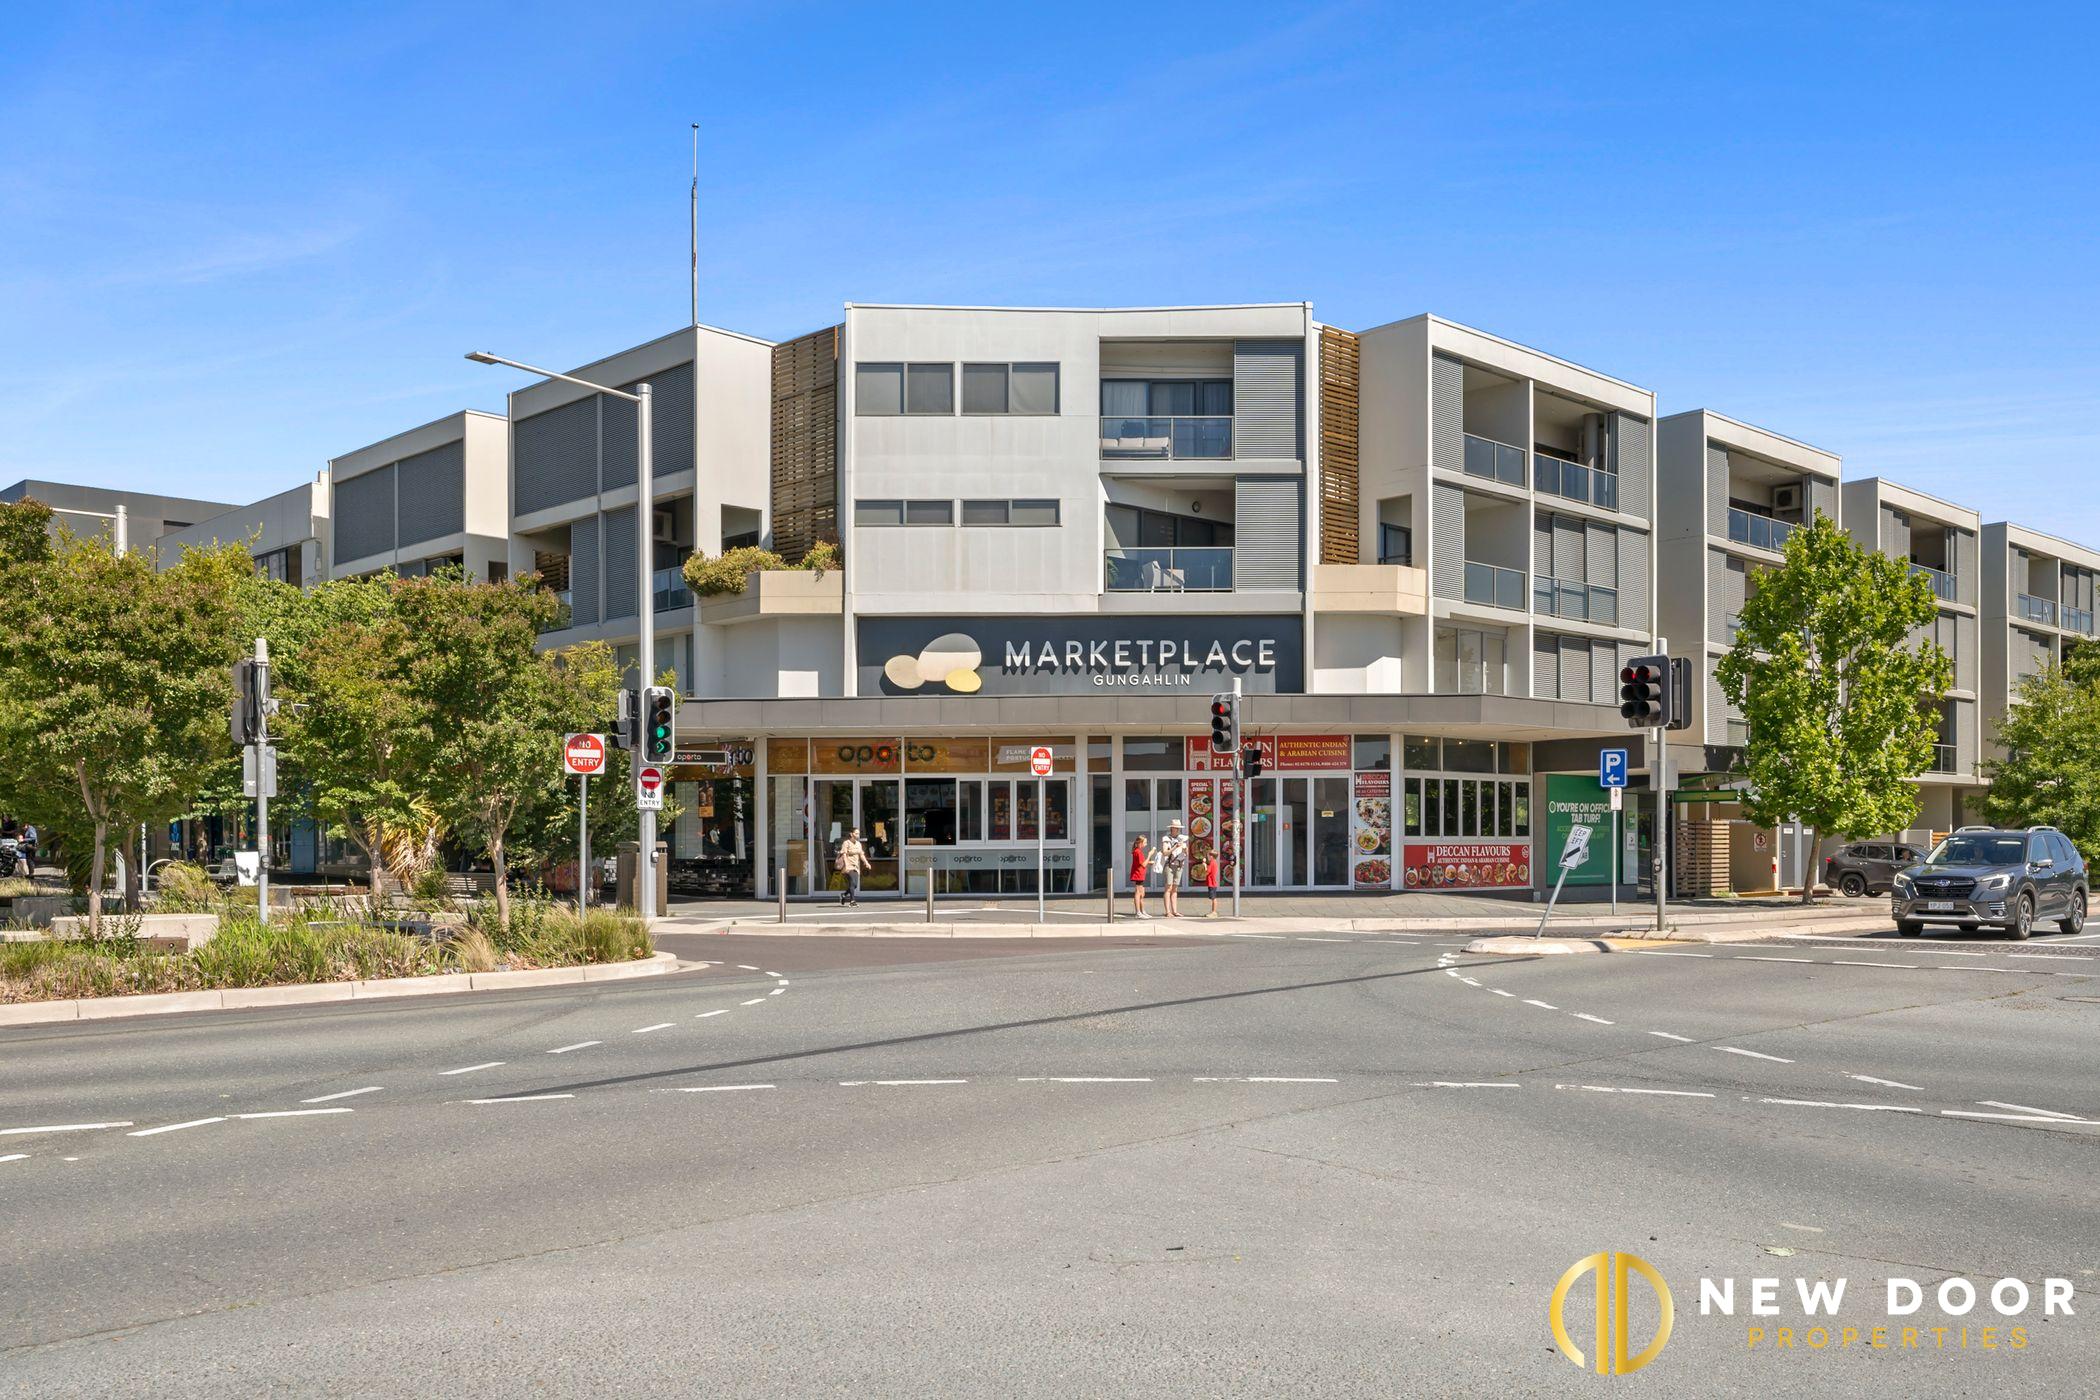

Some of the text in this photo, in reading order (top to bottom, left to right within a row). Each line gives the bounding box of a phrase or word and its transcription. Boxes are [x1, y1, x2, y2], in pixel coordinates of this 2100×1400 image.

[1005, 639, 1276, 668] MARKETPLACE
[1093, 674, 1191, 687] GUNGAHLIN
[579, 740, 591, 749] NO
[677, 753, 702, 761] oporto
[838, 742, 934, 768] oporto
[1038, 751, 1046, 759] NO
[571, 758, 600, 767] ENTRY
[1605, 753, 1621, 773] P
[644, 790, 656, 799] NO
[1556, 803, 1579, 812] YOU'RE
[1580, 803, 1590, 812] ON
[1571, 813, 1601, 824] TAB TURF!
[1436, 845, 1470, 857] DECCAN
[1471, 845, 1511, 857] FLAVOURS
[909, 855, 937, 864] oporto
[953, 855, 982, 864] oporto
[999, 855, 1027, 864] oporto
[1043, 855, 1071, 863] oporto
